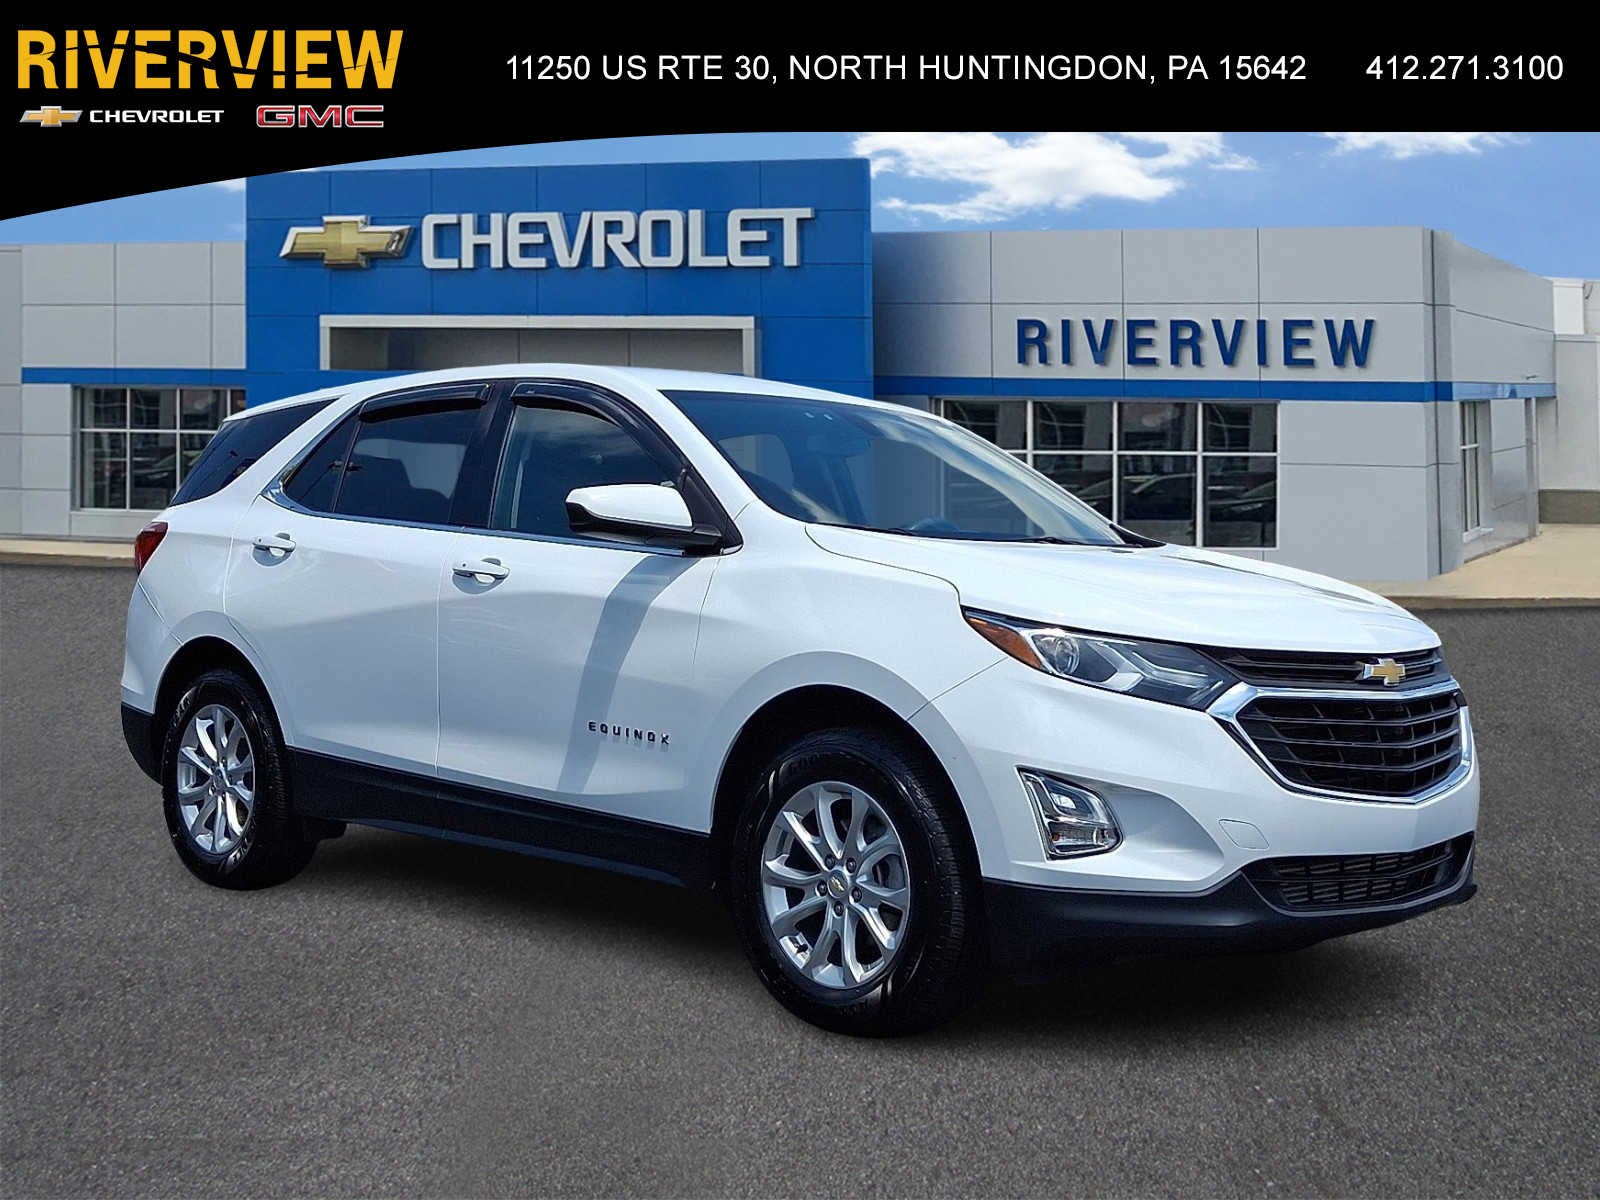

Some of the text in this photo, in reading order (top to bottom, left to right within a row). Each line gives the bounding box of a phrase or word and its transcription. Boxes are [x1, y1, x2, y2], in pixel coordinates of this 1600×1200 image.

[421, 207, 814, 270] CHEVROLET
[1016, 318, 1375, 368] RIVERVIEW
[588, 721, 670, 745] EQUINOX
